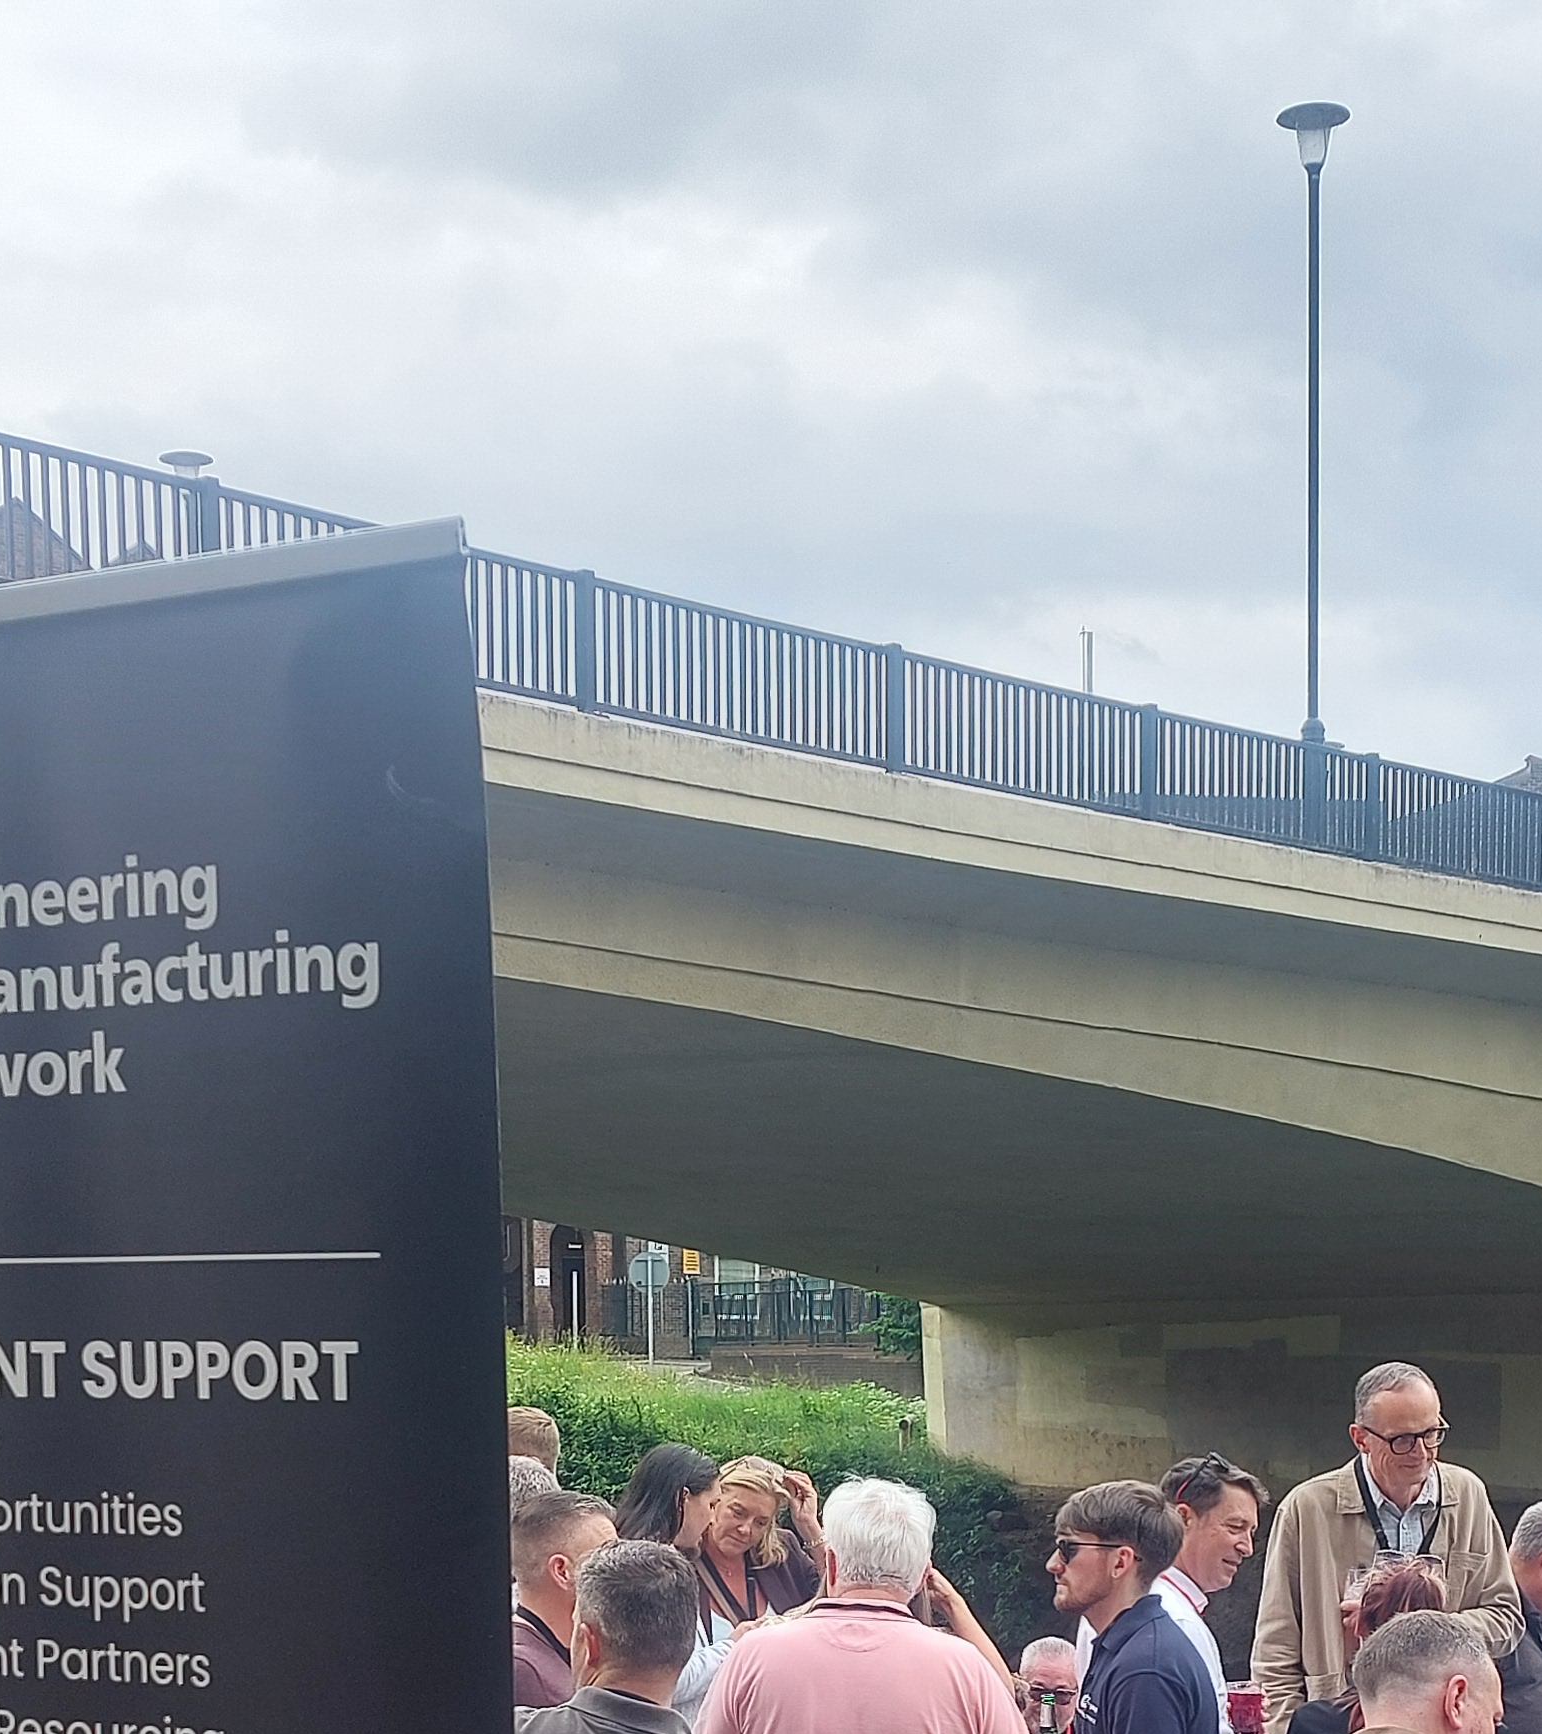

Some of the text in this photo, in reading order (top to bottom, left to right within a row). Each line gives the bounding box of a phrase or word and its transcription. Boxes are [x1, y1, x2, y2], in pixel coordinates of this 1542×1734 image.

[82, 1340, 359, 1401] SUPPORT
[39, 1566, 206, 1623] Support
[36, 1638, 211, 1688] Partners
